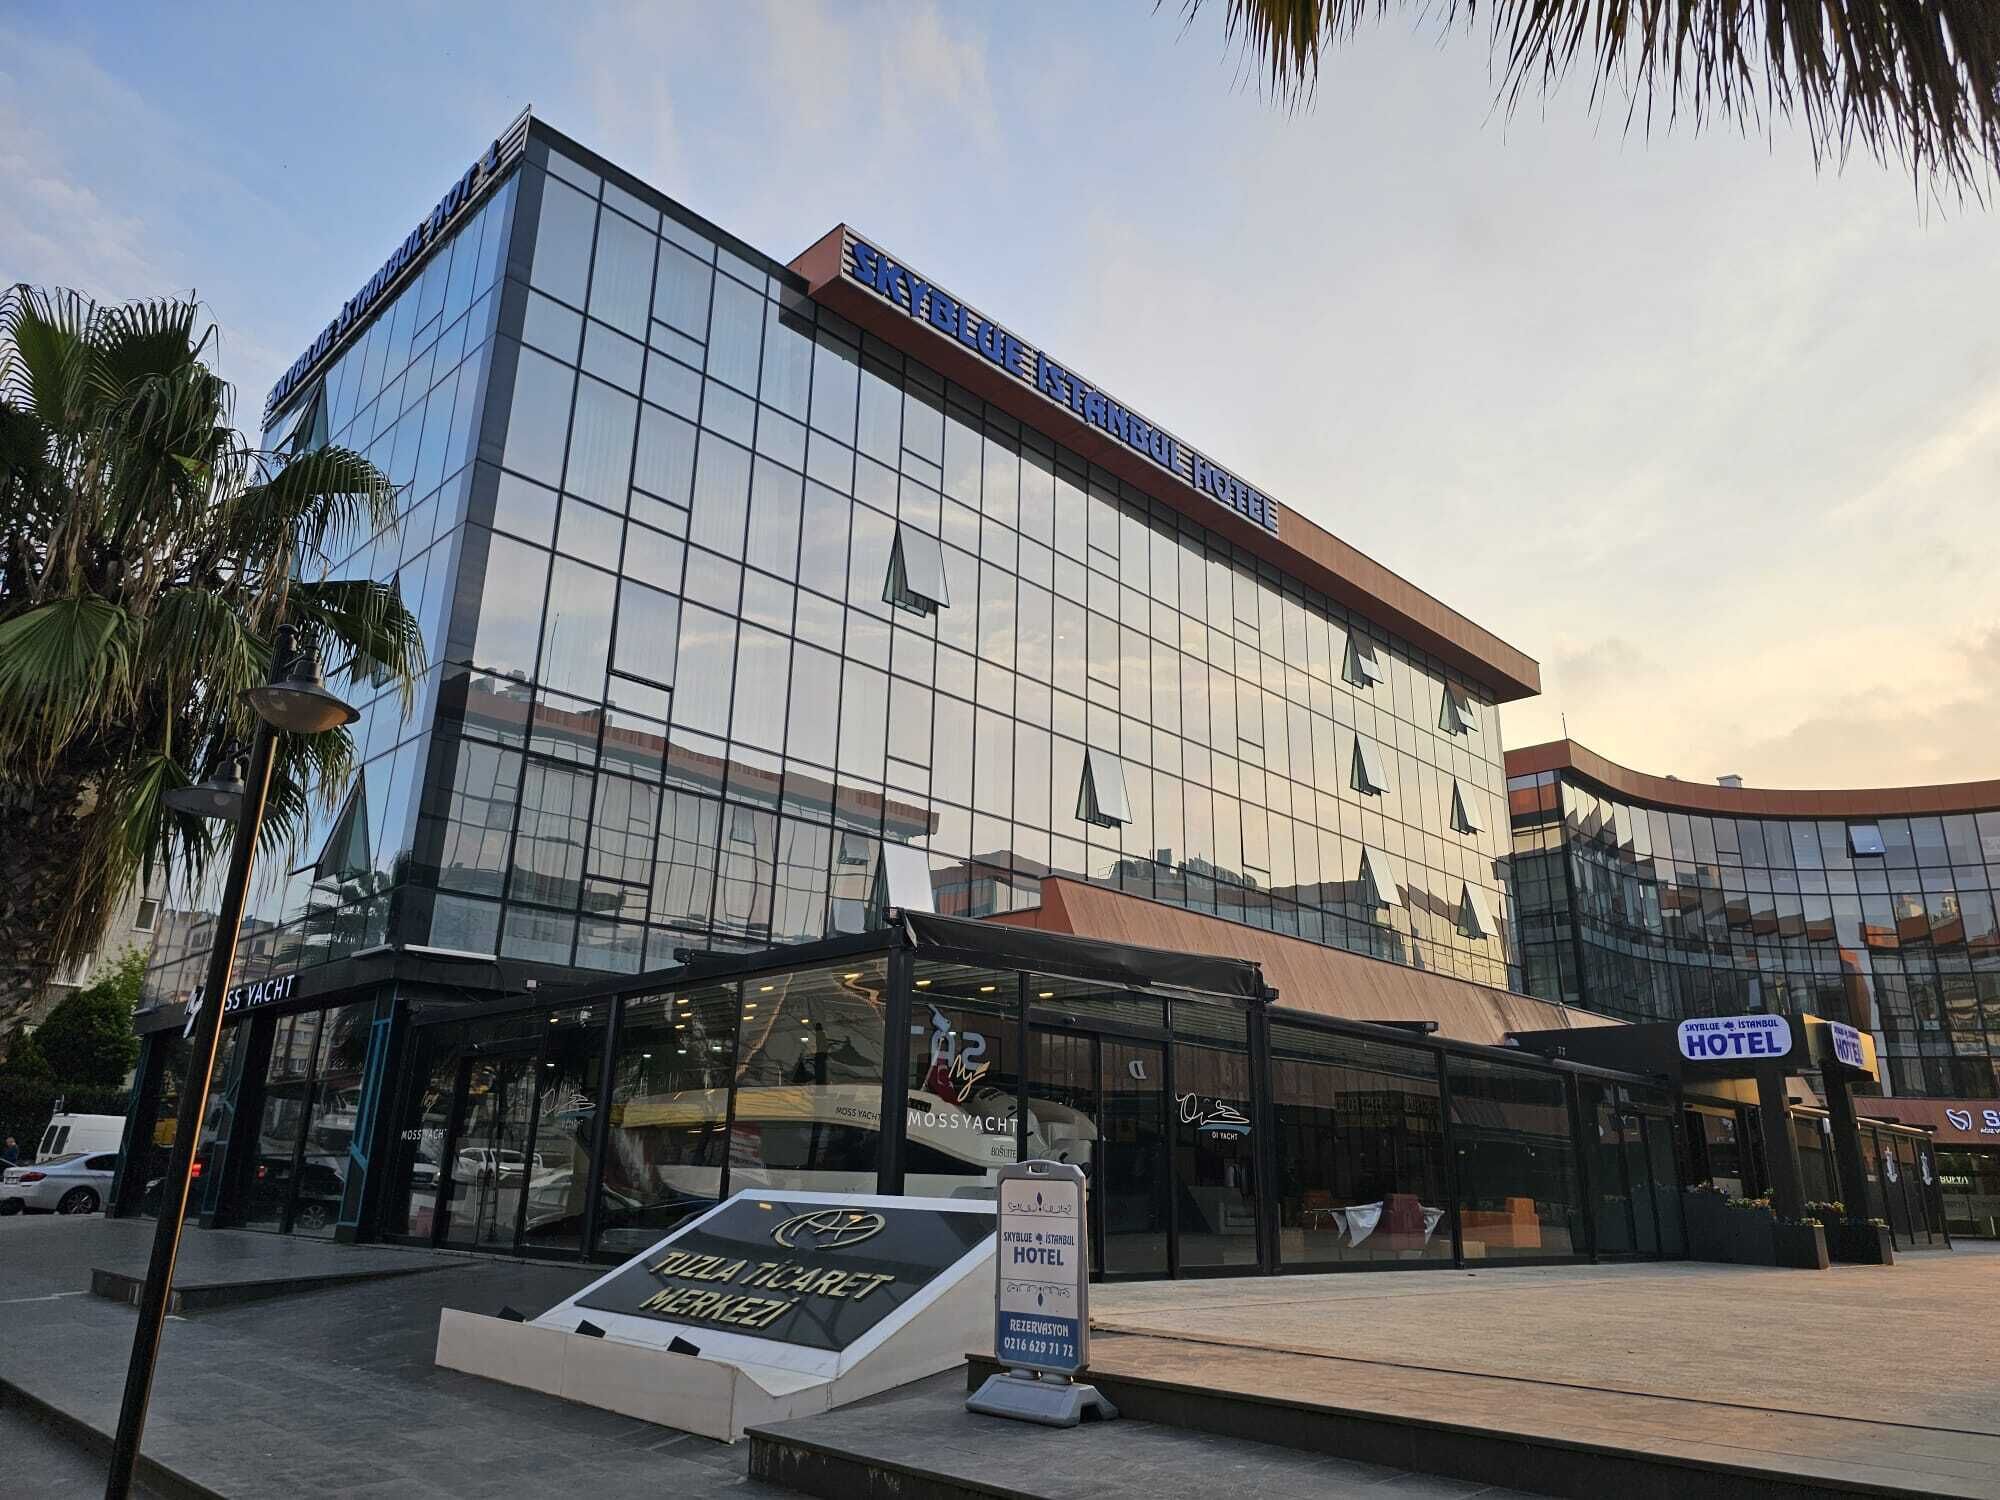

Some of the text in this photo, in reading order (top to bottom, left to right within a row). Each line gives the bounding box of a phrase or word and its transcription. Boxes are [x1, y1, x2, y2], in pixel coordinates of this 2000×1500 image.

[851, 242, 1278, 530] SKYBLUE İSTANBUL HOTEL
[247, 974, 295, 1007] YACHT
[1685, 1023, 1720, 1032] SKYBLUE
[1687, 1031, 1783, 1057] HOTEL
[1835, 1038, 1863, 1064] HOTEL
[907, 1111, 1019, 1134] MOSSYACHT
[1219, 1132, 1239, 1141] YACHT
[1003, 1231, 1033, 1243] SKYBLUE
[1013, 1247, 1064, 1266] HOTEL
[649, 1251, 896, 1300] TUZLA TİCARET
[638, 1286, 800, 1329] MERKEZİ
[1009, 1318, 1069, 1338] REZERVASYON
[1004, 1336, 1074, 1358] 0216 629 71 72
